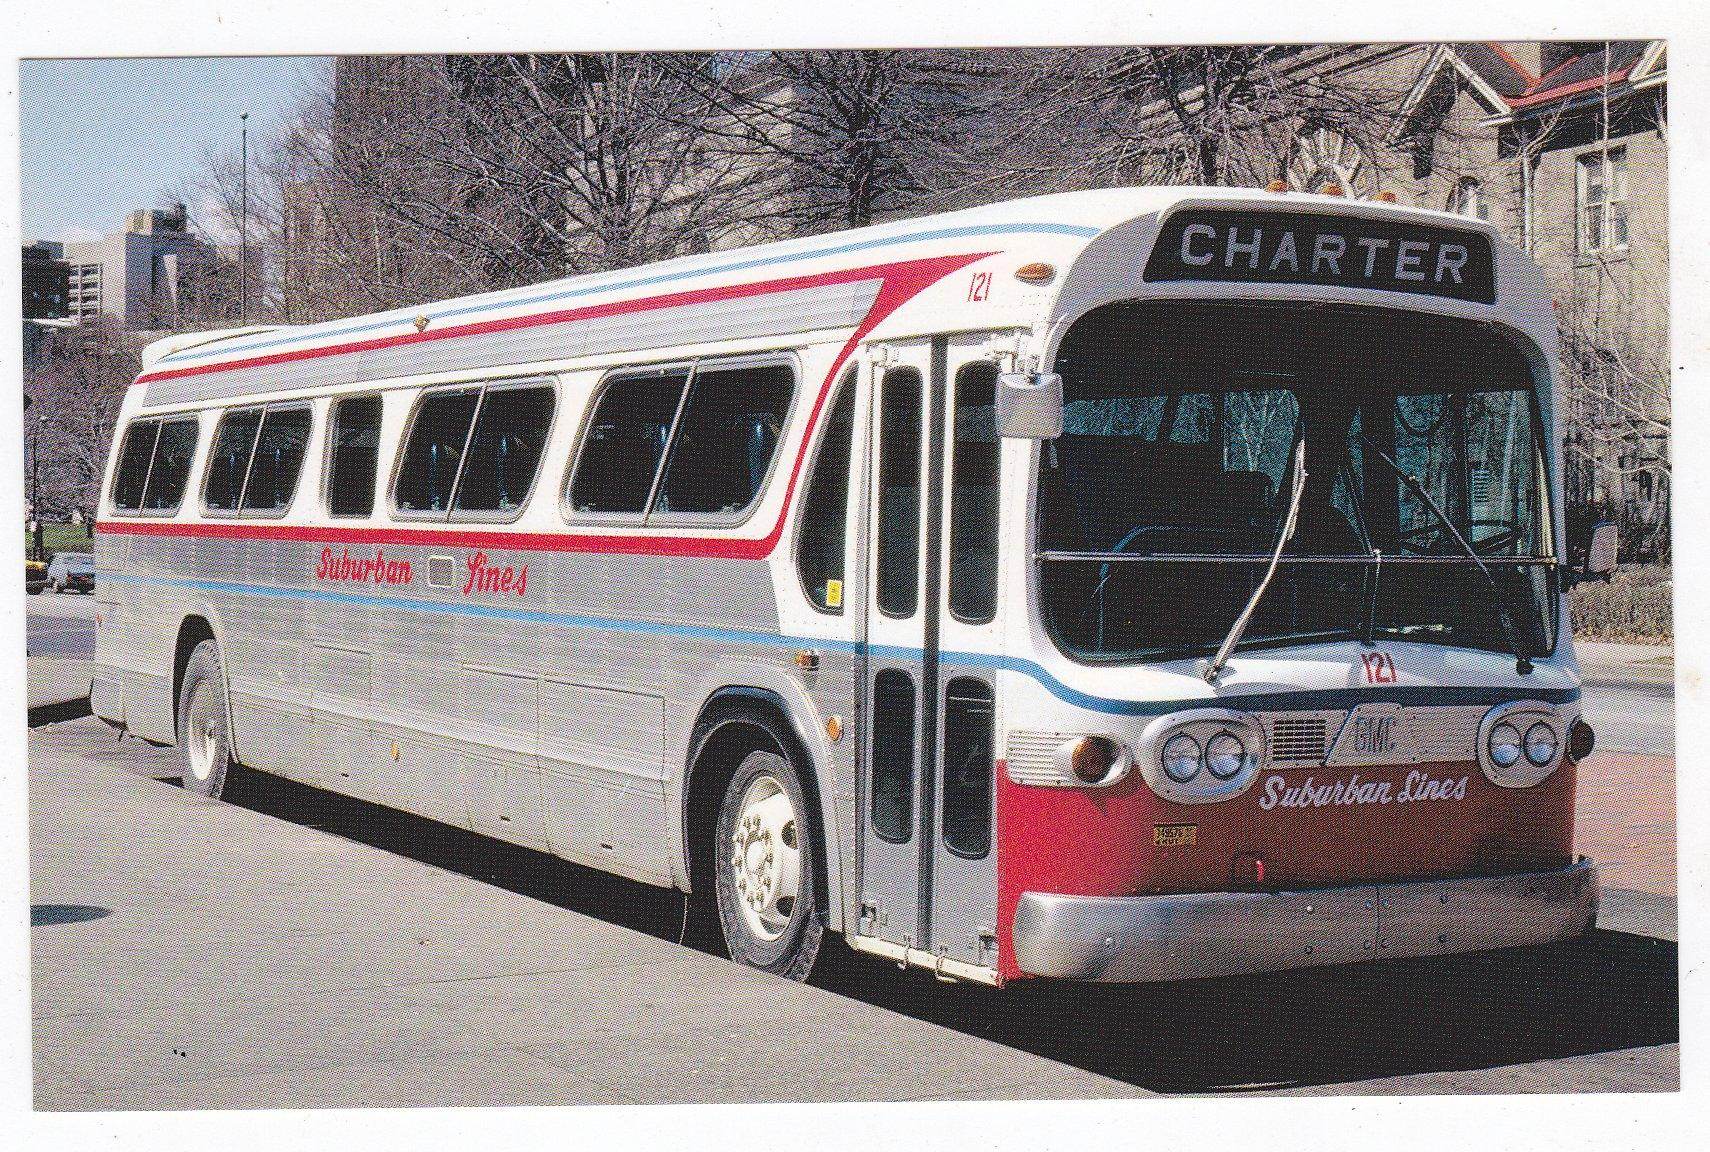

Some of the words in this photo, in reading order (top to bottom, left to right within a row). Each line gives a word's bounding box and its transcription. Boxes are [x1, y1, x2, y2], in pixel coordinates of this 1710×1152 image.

[1180, 222, 1469, 285] CHARTER
[967, 272, 993, 302] 121
[315, 545, 415, 585] Suburban
[462, 551, 529, 597] Lines
[1360, 652, 1398, 684] 121
[1353, 715, 1397, 754] GMC
[1258, 773, 1394, 811] Suburban
[1396, 769, 1470, 803] Lines
